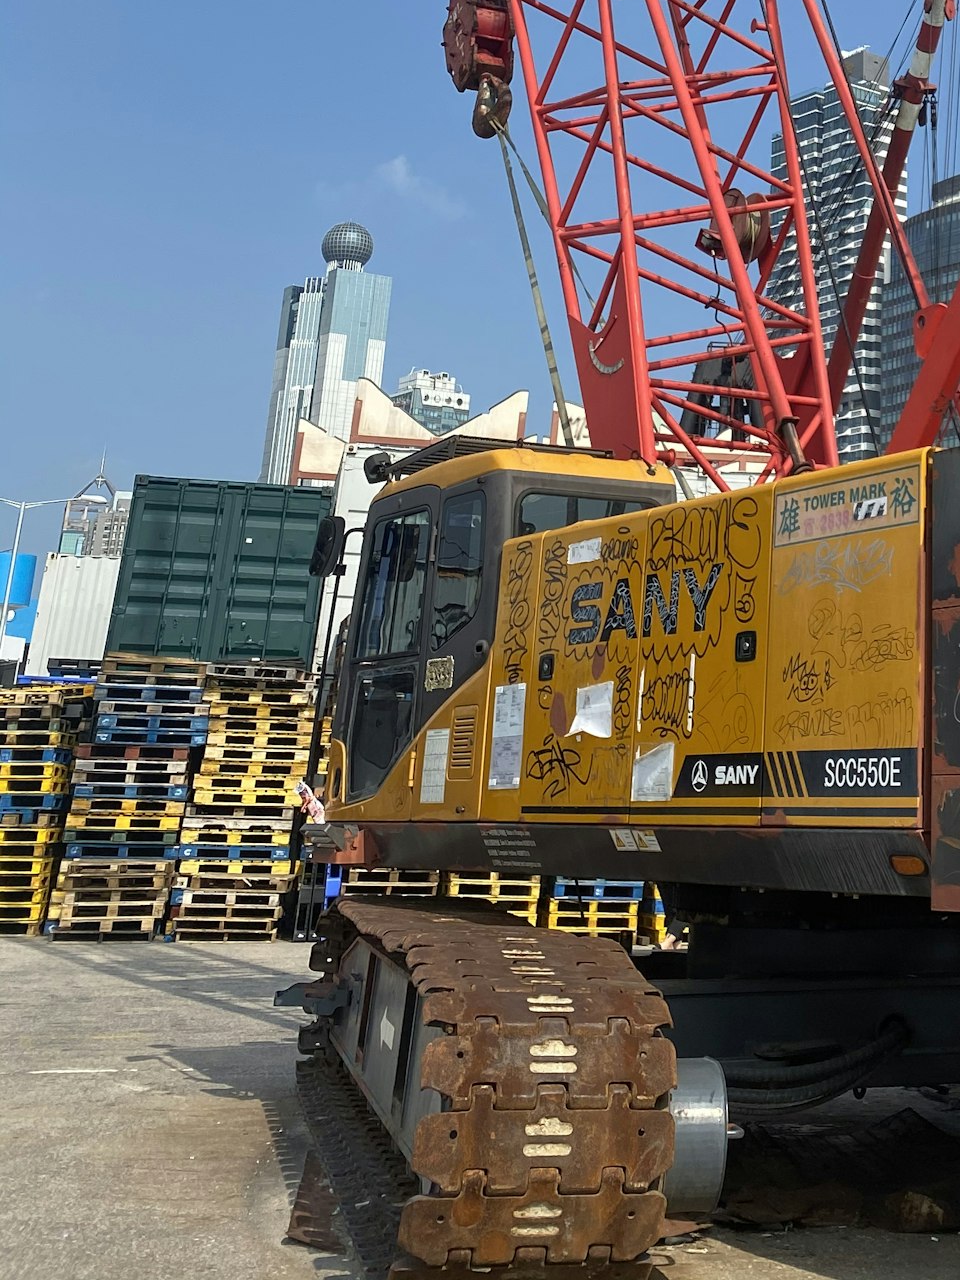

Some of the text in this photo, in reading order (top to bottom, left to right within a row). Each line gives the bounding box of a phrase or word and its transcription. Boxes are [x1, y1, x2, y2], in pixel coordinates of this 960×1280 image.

[777, 497, 800, 541] 雄
[804, 490, 845, 512] TOWER
[850, 481, 887, 503] MARK
[890, 477, 916, 519] 裕
[569, 563, 724, 646] SANY
[714, 764, 759, 785] SANY
[824, 756, 902, 788] SCC550E
